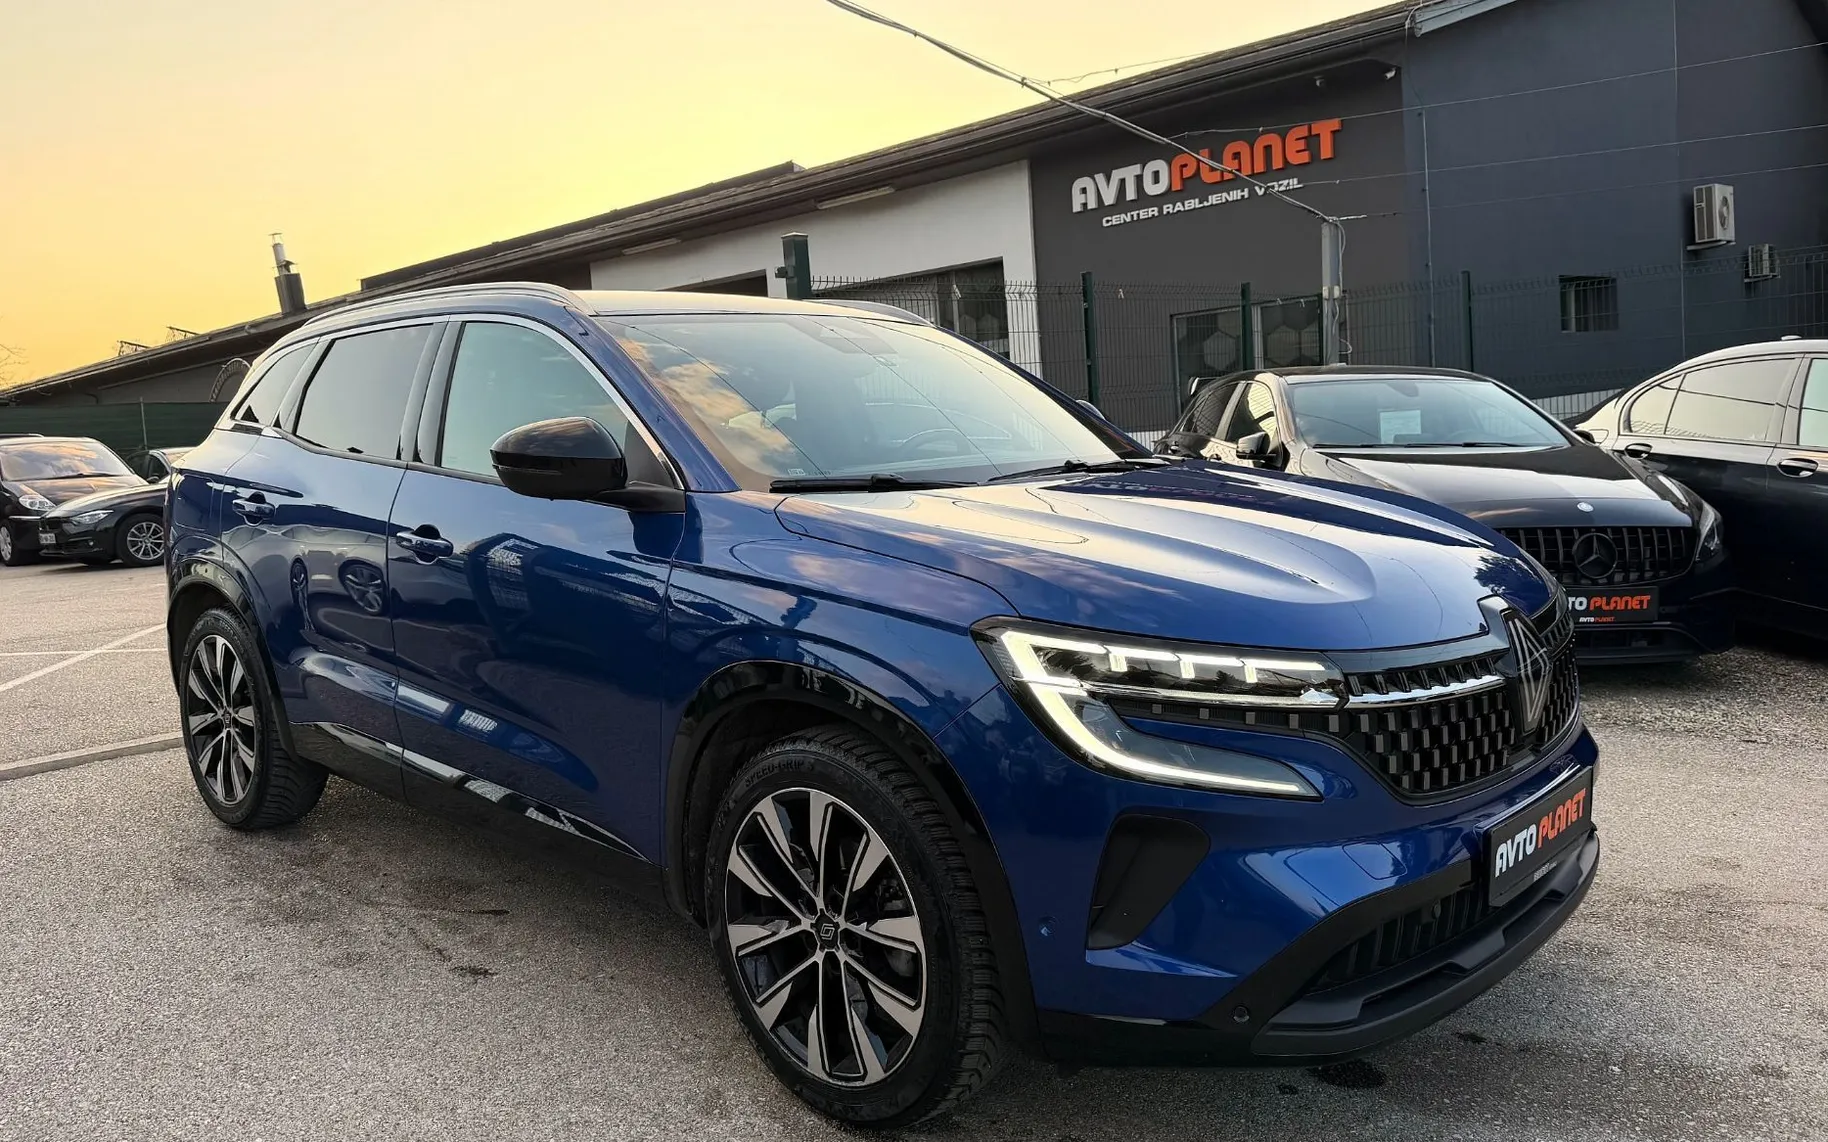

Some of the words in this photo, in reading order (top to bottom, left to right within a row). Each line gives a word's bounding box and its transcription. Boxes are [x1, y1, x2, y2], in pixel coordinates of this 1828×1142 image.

[1102, 206, 1159, 227] CENTER
[1163, 187, 1250, 215] RABLJENIH
[1589, 595, 1651, 611] PLANET
[1495, 823, 1537, 878] AVTO
[1537, 788, 1587, 849] PLANET
